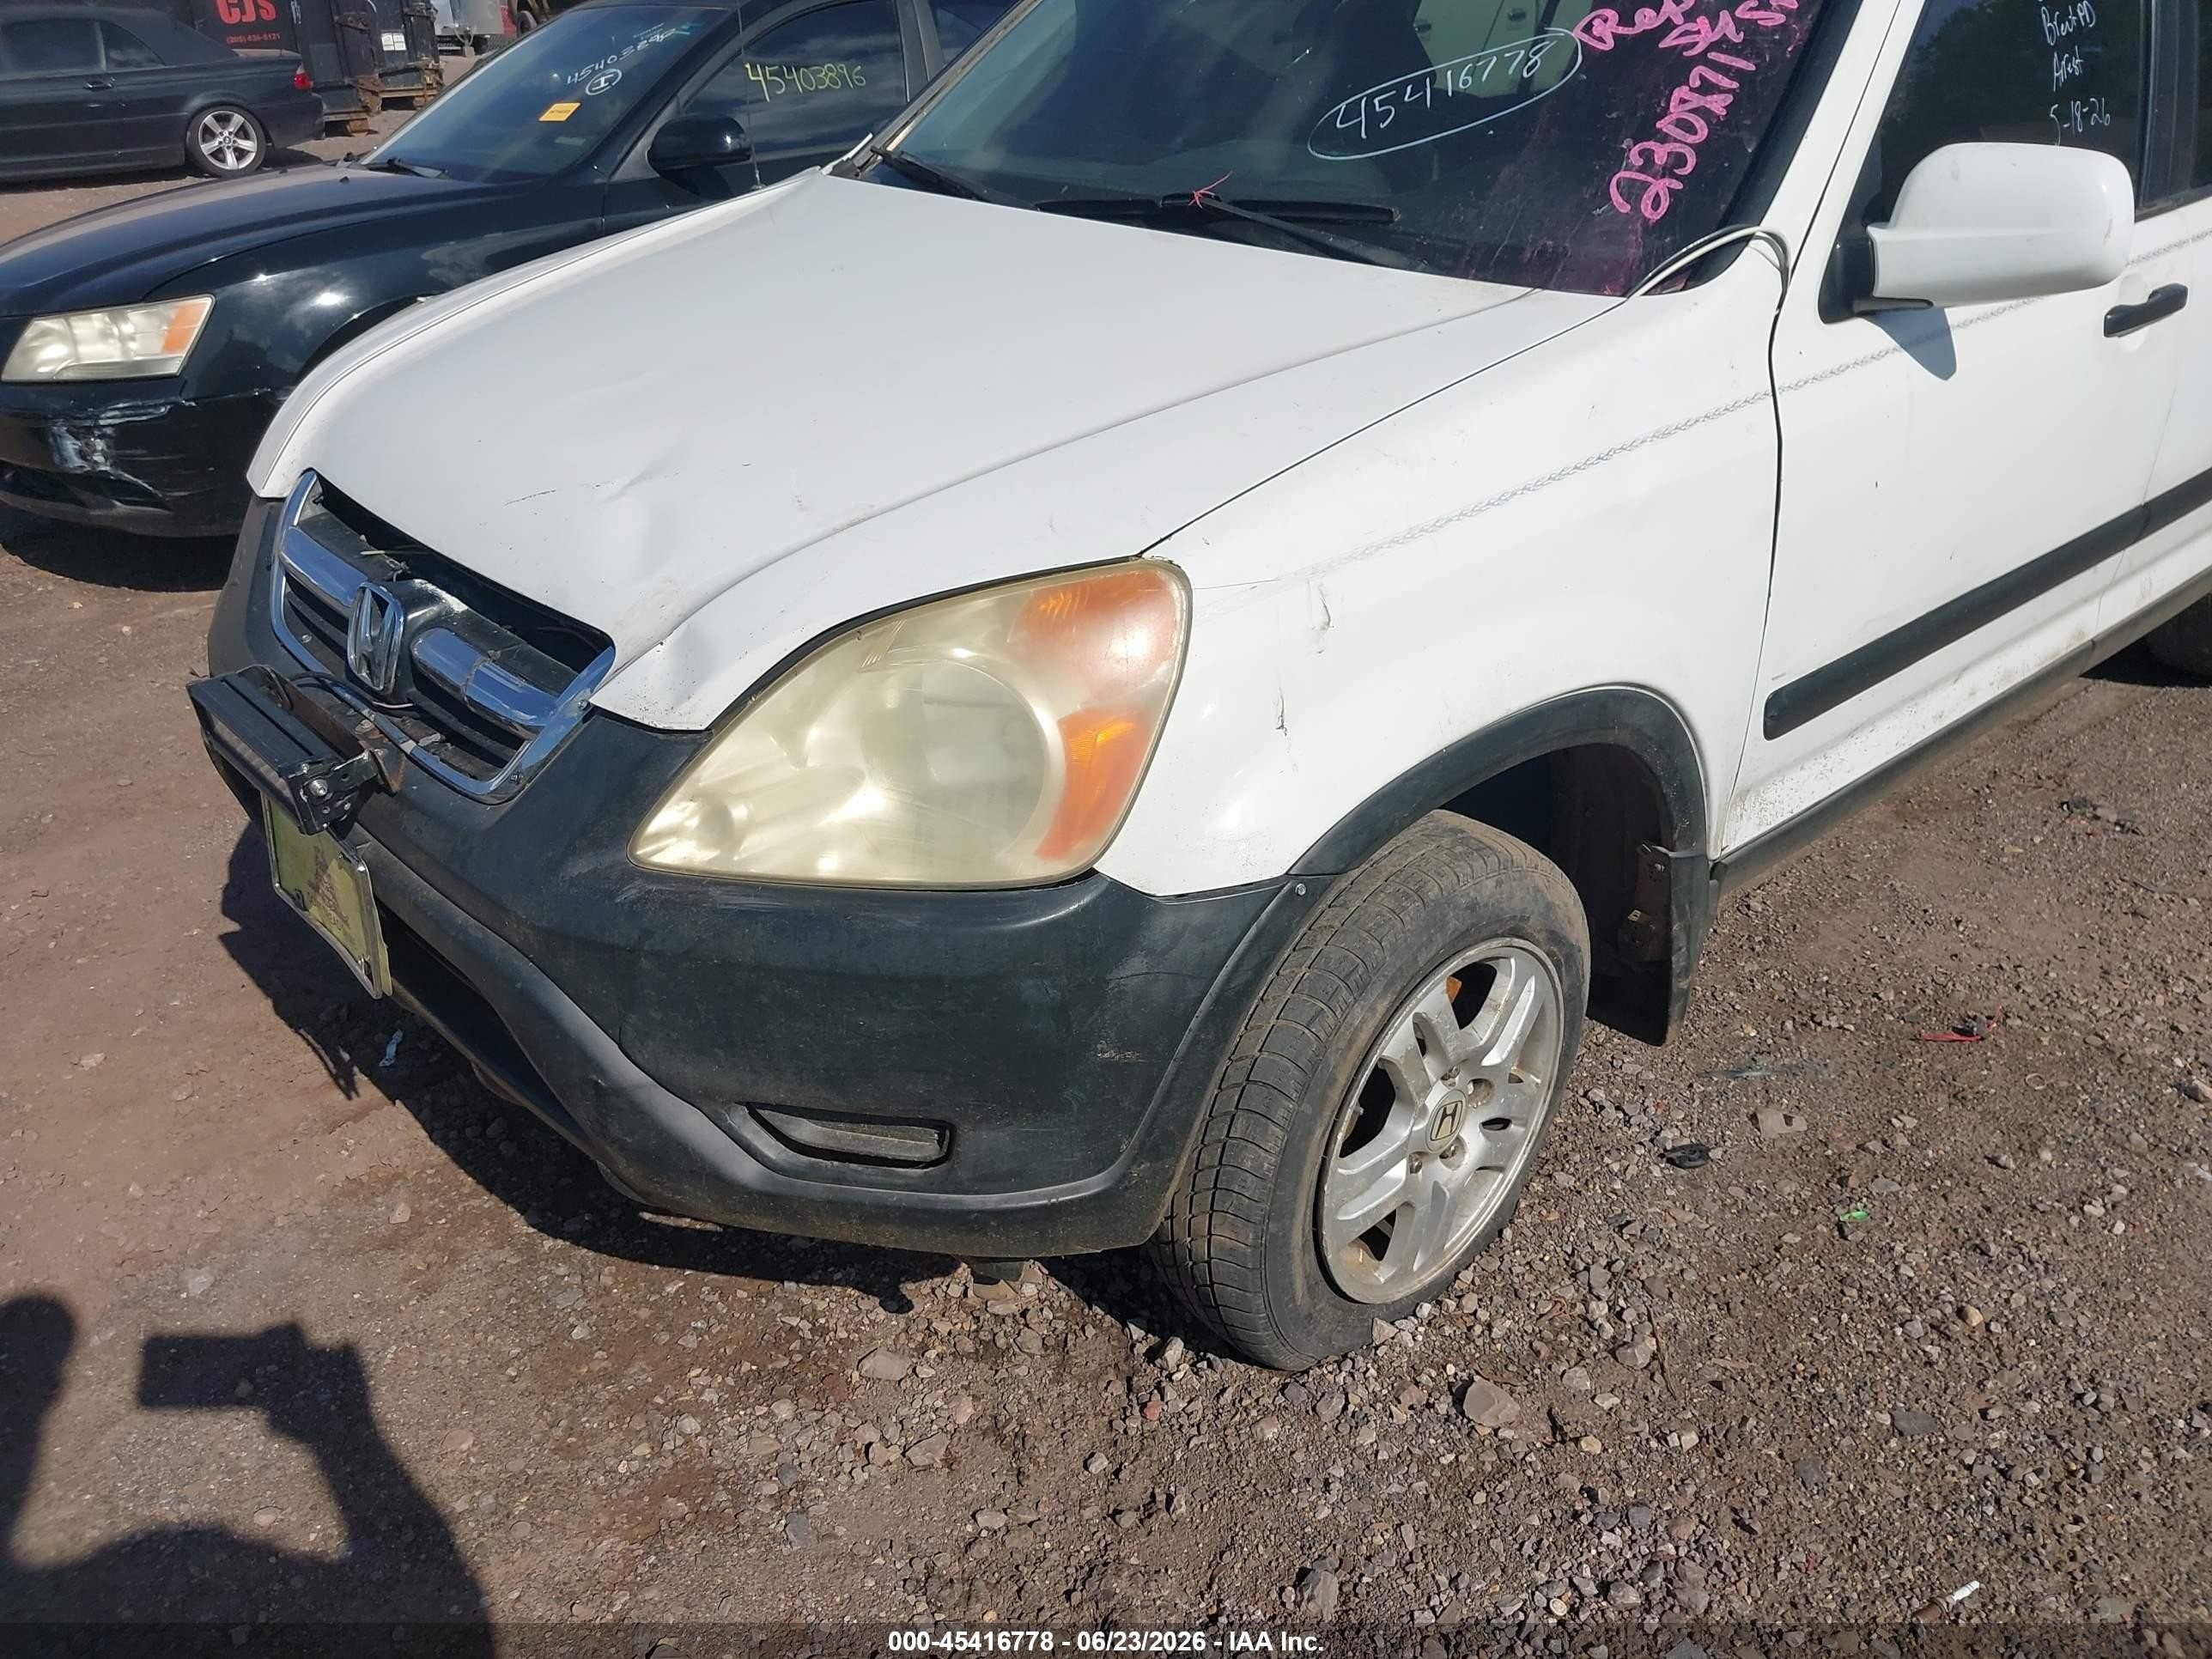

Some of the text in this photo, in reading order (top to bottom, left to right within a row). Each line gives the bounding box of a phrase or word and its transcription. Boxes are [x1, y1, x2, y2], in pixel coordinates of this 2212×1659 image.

[744, 63, 866, 102] 45403896
[1336, 40, 1558, 139] 45416778
[2049, 97, 2111, 146] 5-18-26
